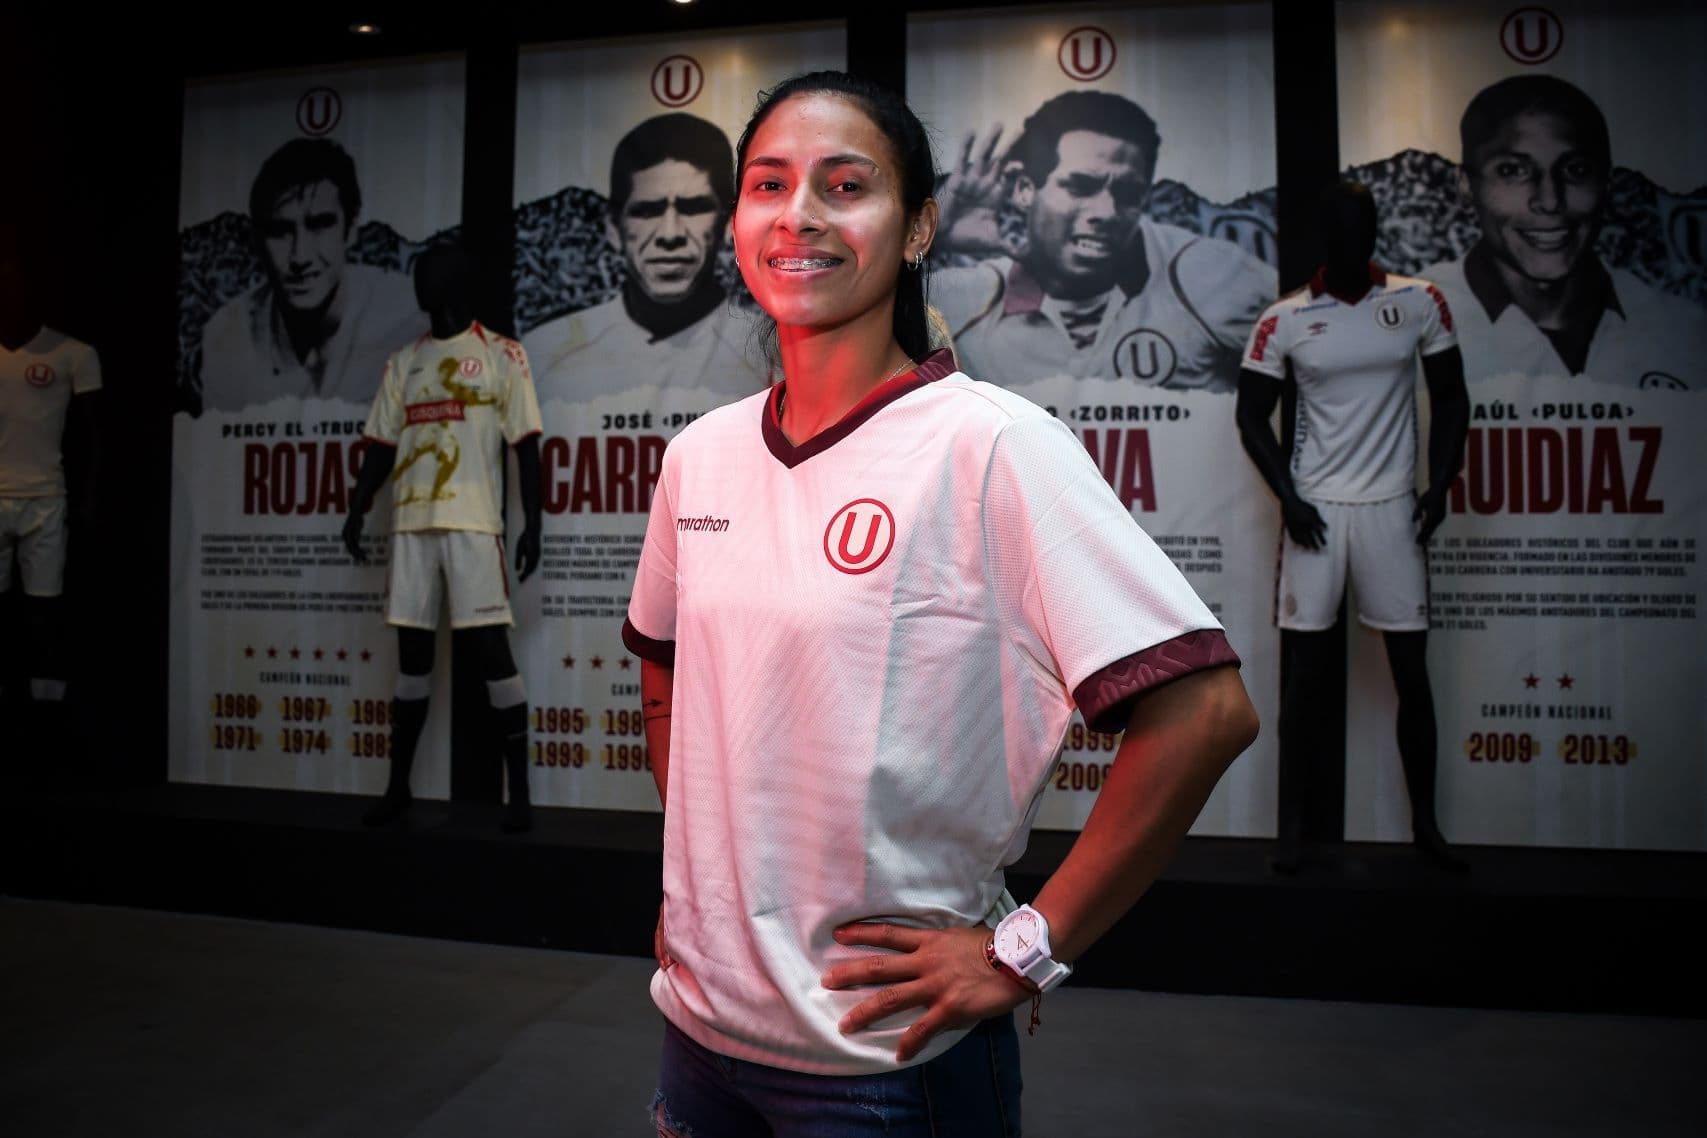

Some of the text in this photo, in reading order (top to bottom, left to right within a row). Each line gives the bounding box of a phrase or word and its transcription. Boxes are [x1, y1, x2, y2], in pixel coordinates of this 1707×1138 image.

[602, 409, 652, 429] JOSÉ
[1474, 400, 1518, 420] AÚL
[222, 423, 276, 437] PERCY
[285, 422, 304, 436] EL
[542, 436, 668, 514] CARR
[1082, 429, 1157, 512] VA
[282, 696, 326, 721] 1967
[534, 707, 643, 736] 1985 198
[1481, 701, 1613, 721] CAMPEÓN NACIONAL
[215, 725, 256, 751] 1971
[282, 728, 326, 755] 1974
[1063, 725, 1115, 751] 999
[1469, 733, 1629, 765] 2009 2013
